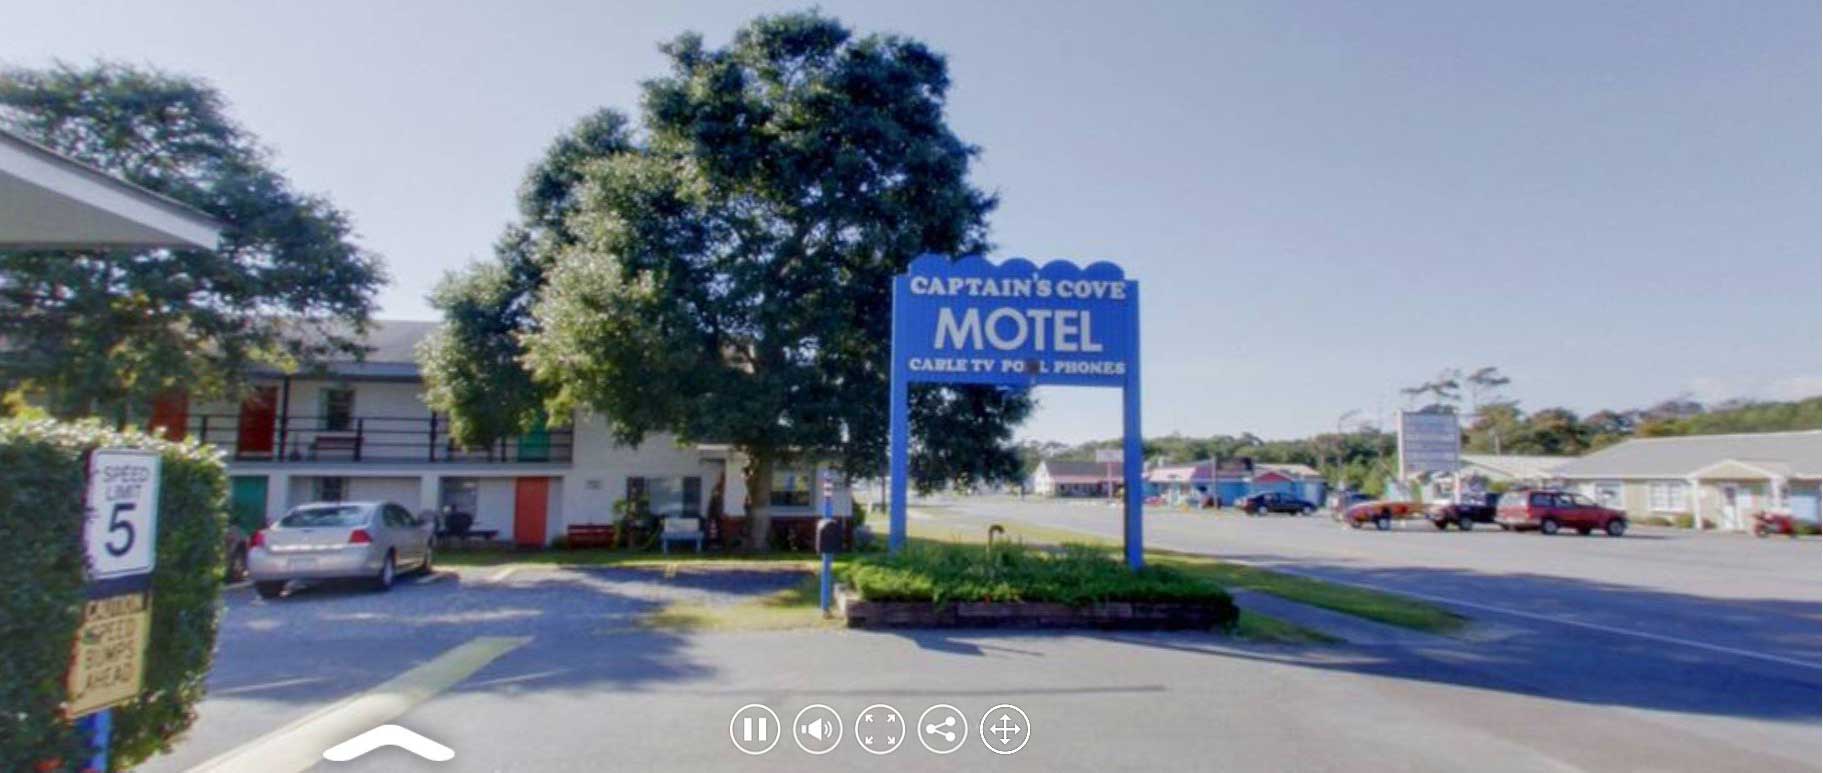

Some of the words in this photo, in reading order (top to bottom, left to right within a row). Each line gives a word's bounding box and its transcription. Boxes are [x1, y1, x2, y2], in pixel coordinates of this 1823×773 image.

[910, 272, 1052, 298] CAPTAIN'S
[1056, 279, 1126, 299] COVE
[933, 306, 1103, 352] MOTEL
[909, 357, 967, 372] CABLE
[971, 358, 995, 372] TV
[1001, 359, 1049, 373] POL
[1053, 361, 1126, 375] PHONES
[103, 465, 150, 483] SPEED
[105, 484, 143, 500] LIMIT
[104, 502, 137, 558] 5
[86, 661, 133, 689] AHEAD
